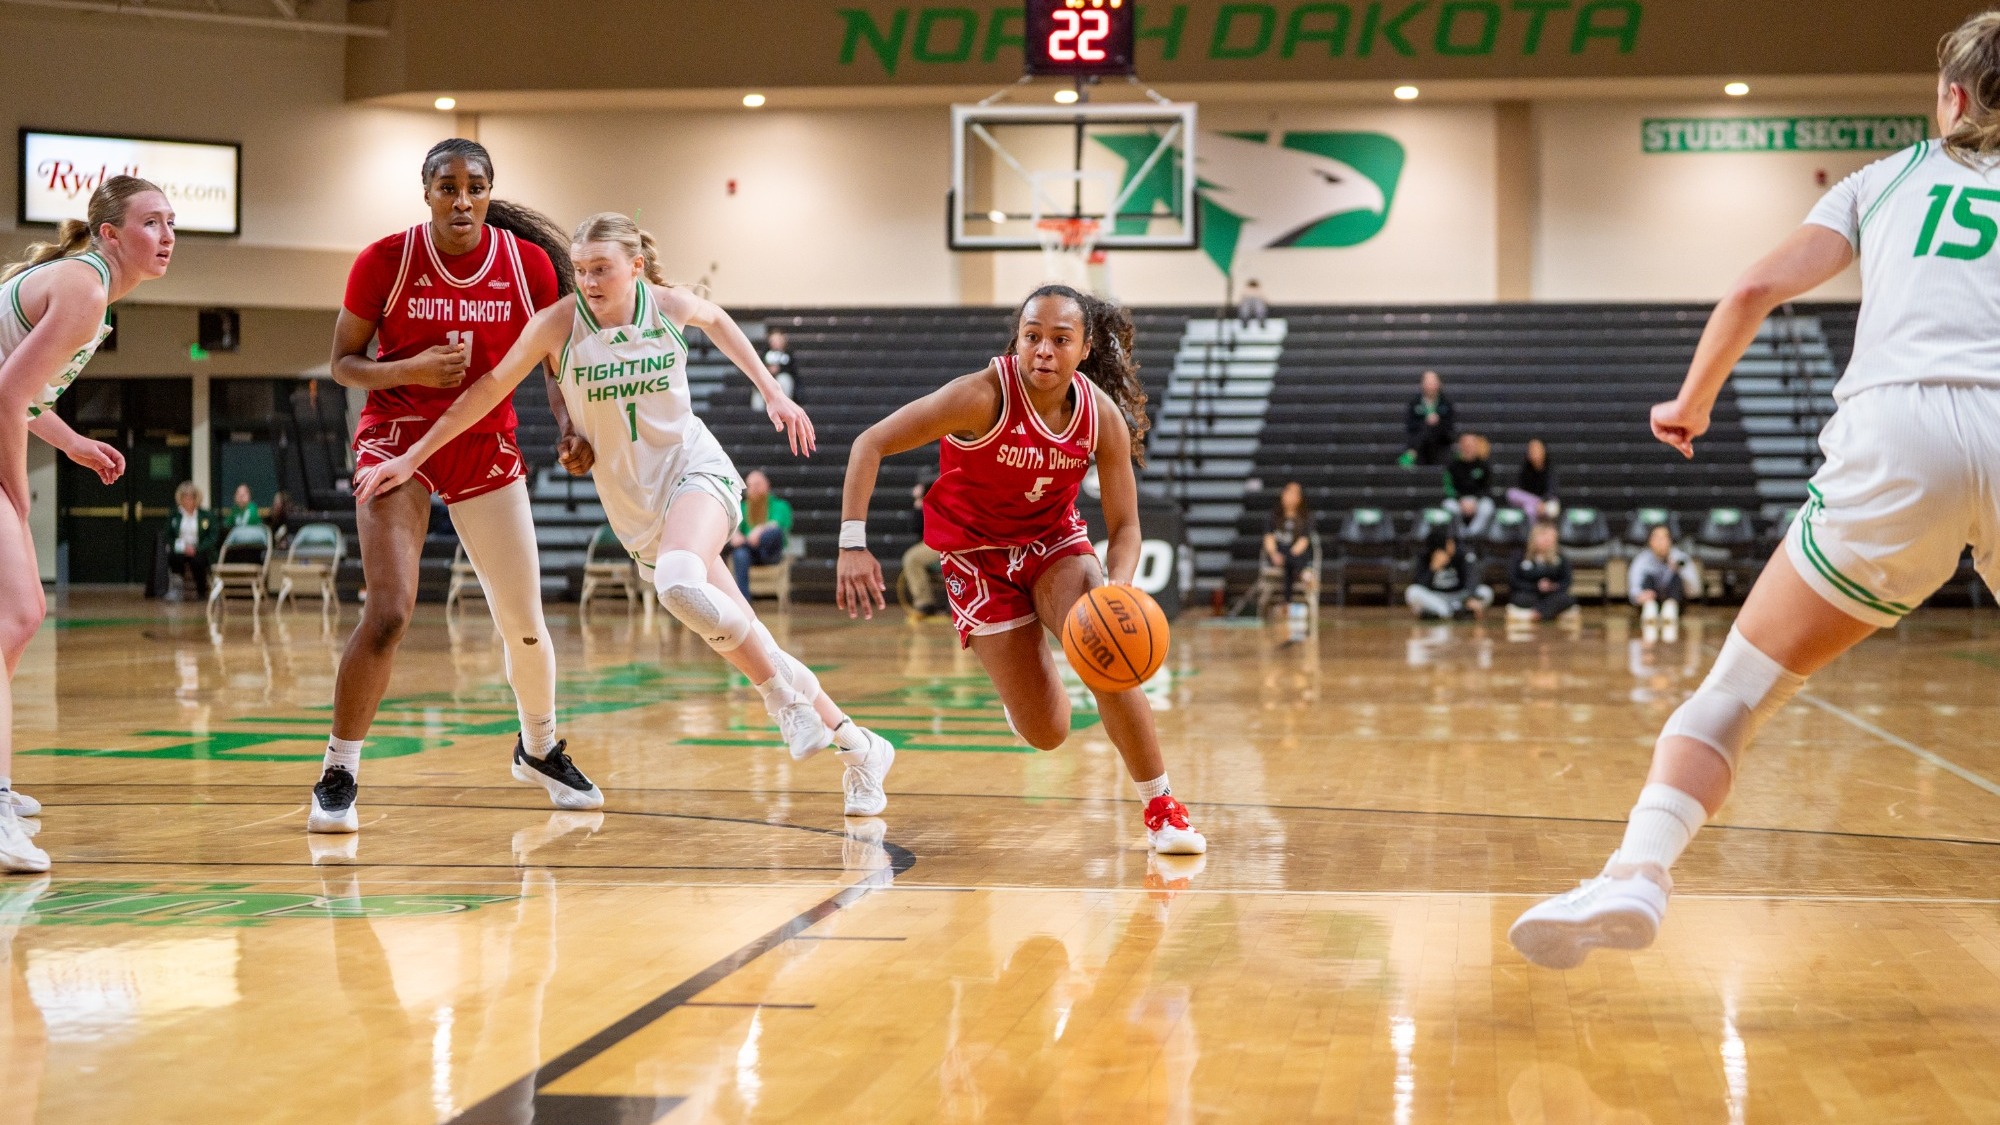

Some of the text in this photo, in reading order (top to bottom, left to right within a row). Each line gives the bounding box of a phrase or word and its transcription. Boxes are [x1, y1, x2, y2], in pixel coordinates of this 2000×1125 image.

[834, 1, 1643, 78] NORH DAKOTA
[1048, 9, 1109, 60] 22
[1645, 119, 1924, 149] STUDENT SECTION
[1912, 183, 2000, 261] 15
[407, 297, 512, 322] SOUTH DAKOTA
[572, 352, 675, 386] FIGHTING
[587, 375, 670, 402] HAWKS
[626, 402, 638, 442] 1
[996, 443, 1044, 470] SOUTH
[1024, 477, 1054, 503] 5
